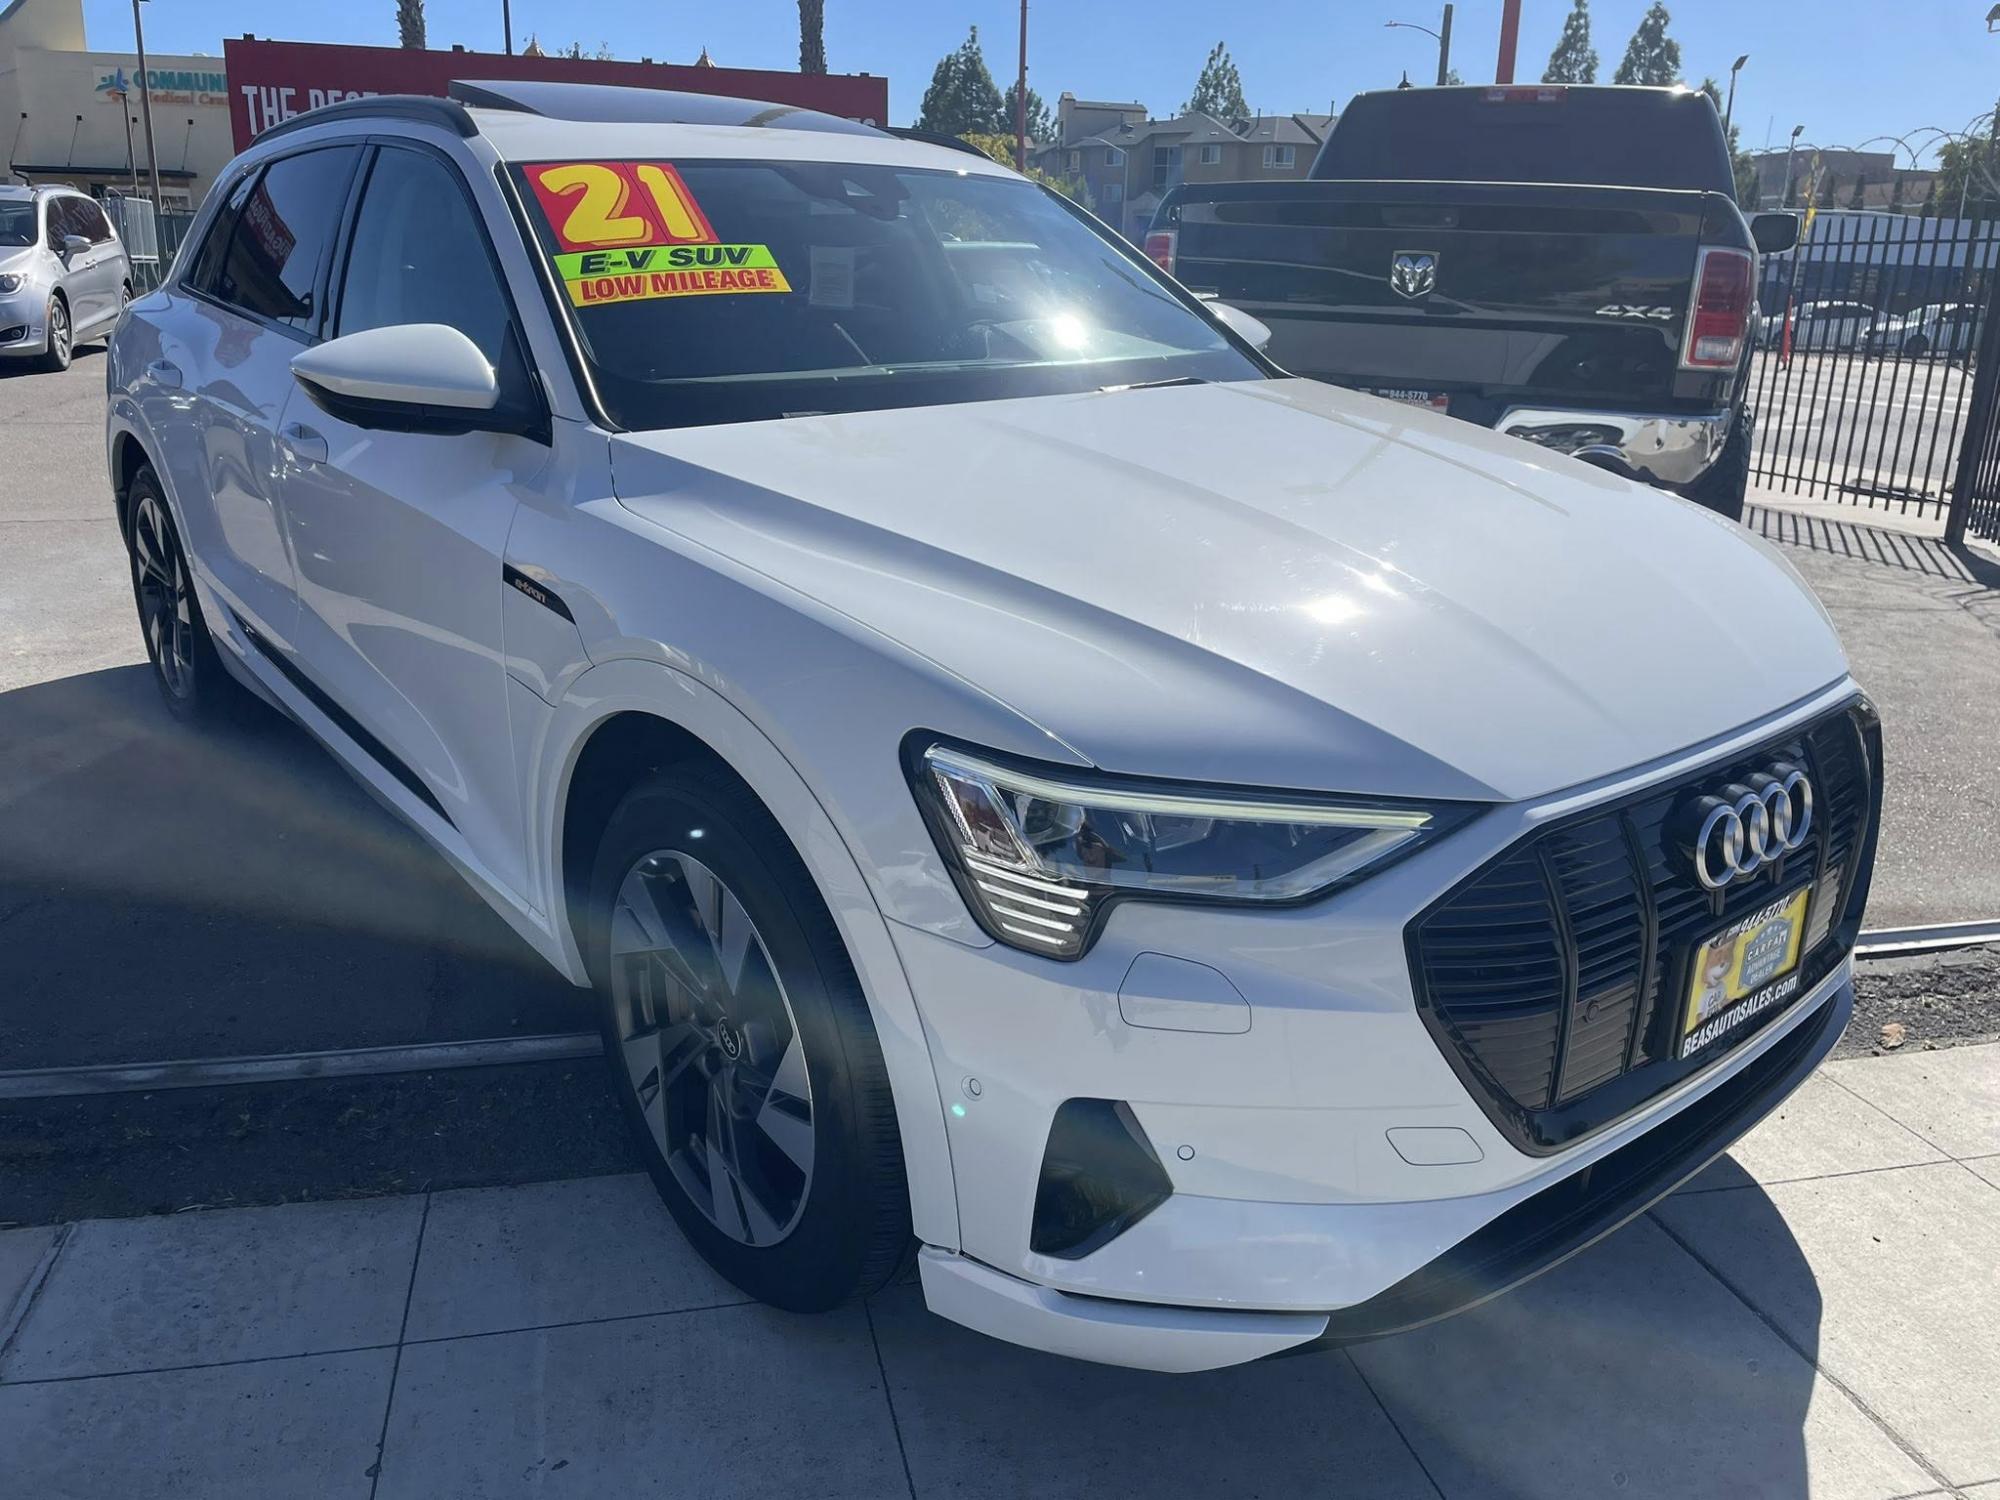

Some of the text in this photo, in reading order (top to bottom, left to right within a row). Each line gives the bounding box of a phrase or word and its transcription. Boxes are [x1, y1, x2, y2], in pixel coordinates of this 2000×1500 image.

[149, 90, 194, 105] edical
[241, 85, 298, 136] THE
[538, 164, 709, 246] 21
[580, 246, 751, 276] E-V SUV
[580, 268, 777, 302] LOW MILEAGE
[1389, 389, 1429, 400] 944-5770
[1739, 895, 1790, 936] 944-5770
[1682, 975, 1798, 1059] BEASAUTOSALES.com
